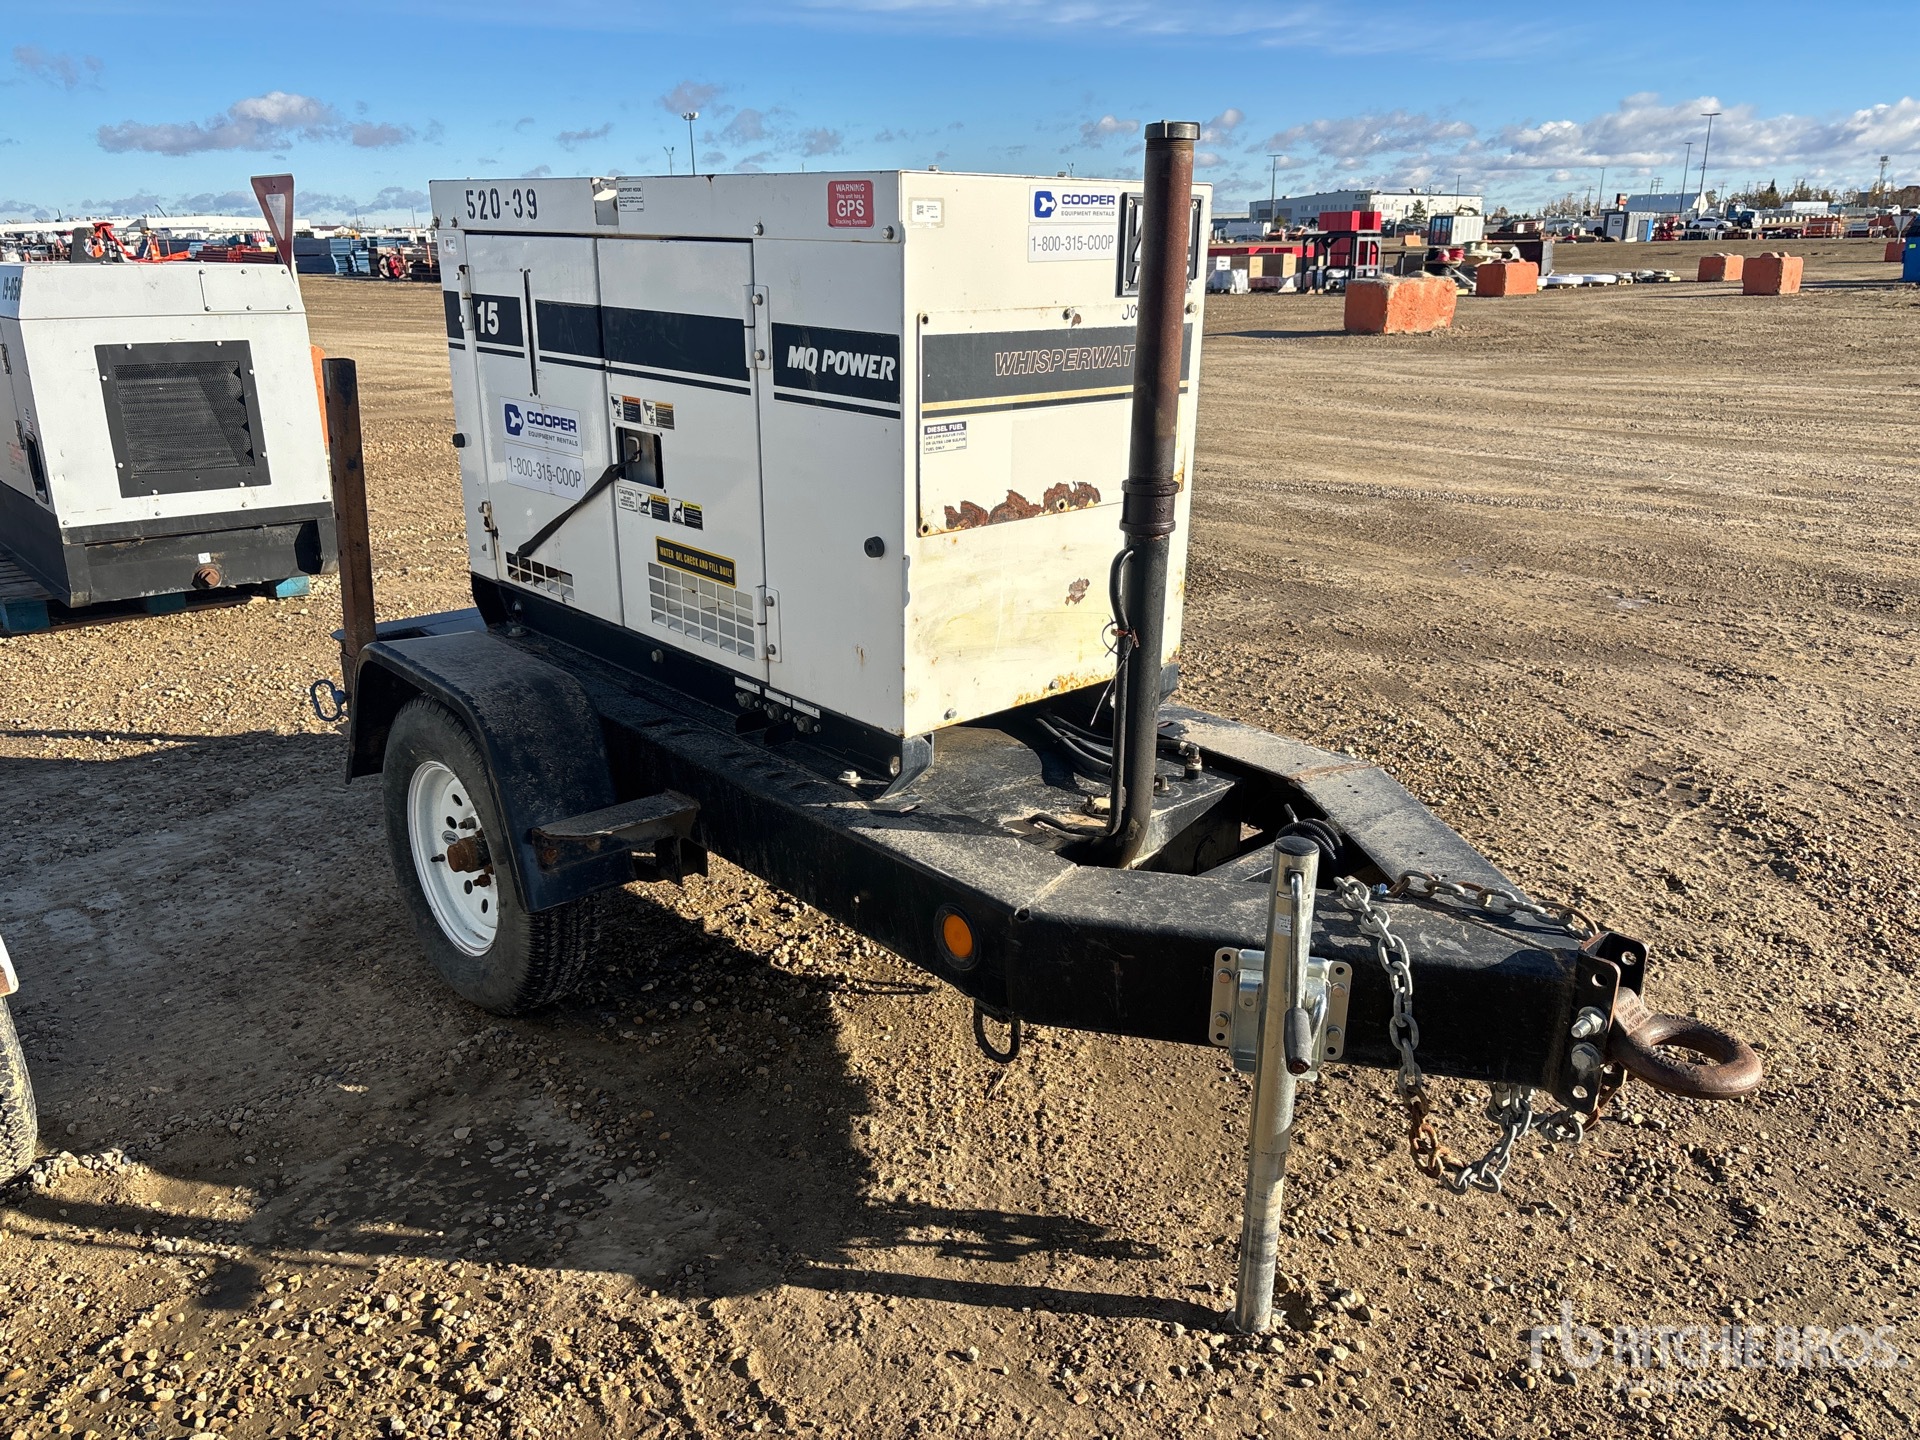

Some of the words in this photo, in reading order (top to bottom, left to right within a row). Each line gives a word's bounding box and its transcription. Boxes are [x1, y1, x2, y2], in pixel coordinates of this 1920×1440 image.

[836, 183, 865, 192] WARNING
[465, 187, 538, 220] 520-39
[836, 199, 865, 218] GPS
[1061, 194, 1116, 206] COOPER
[835, 218, 852, 226] Tracking
[852, 218, 867, 226] System
[1031, 234, 1114, 252] 1-800-315-COOP
[477, 300, 499, 336] 15
[787, 345, 819, 376] MQ
[821, 349, 896, 382] POWER
[995, 344, 1137, 377] WHISPERWAT
[526, 410, 577, 433] COOPER
[927, 425, 948, 433] DIESEL
[528, 430, 555, 442] EQUIPMENT
[556, 436, 579, 447] RENTALS
[508, 455, 581, 489] 1-800-315-COOP
[683, 554, 699, 568] CHECK
[699, 558, 709, 570] AND
[709, 561, 719, 574] FILL
